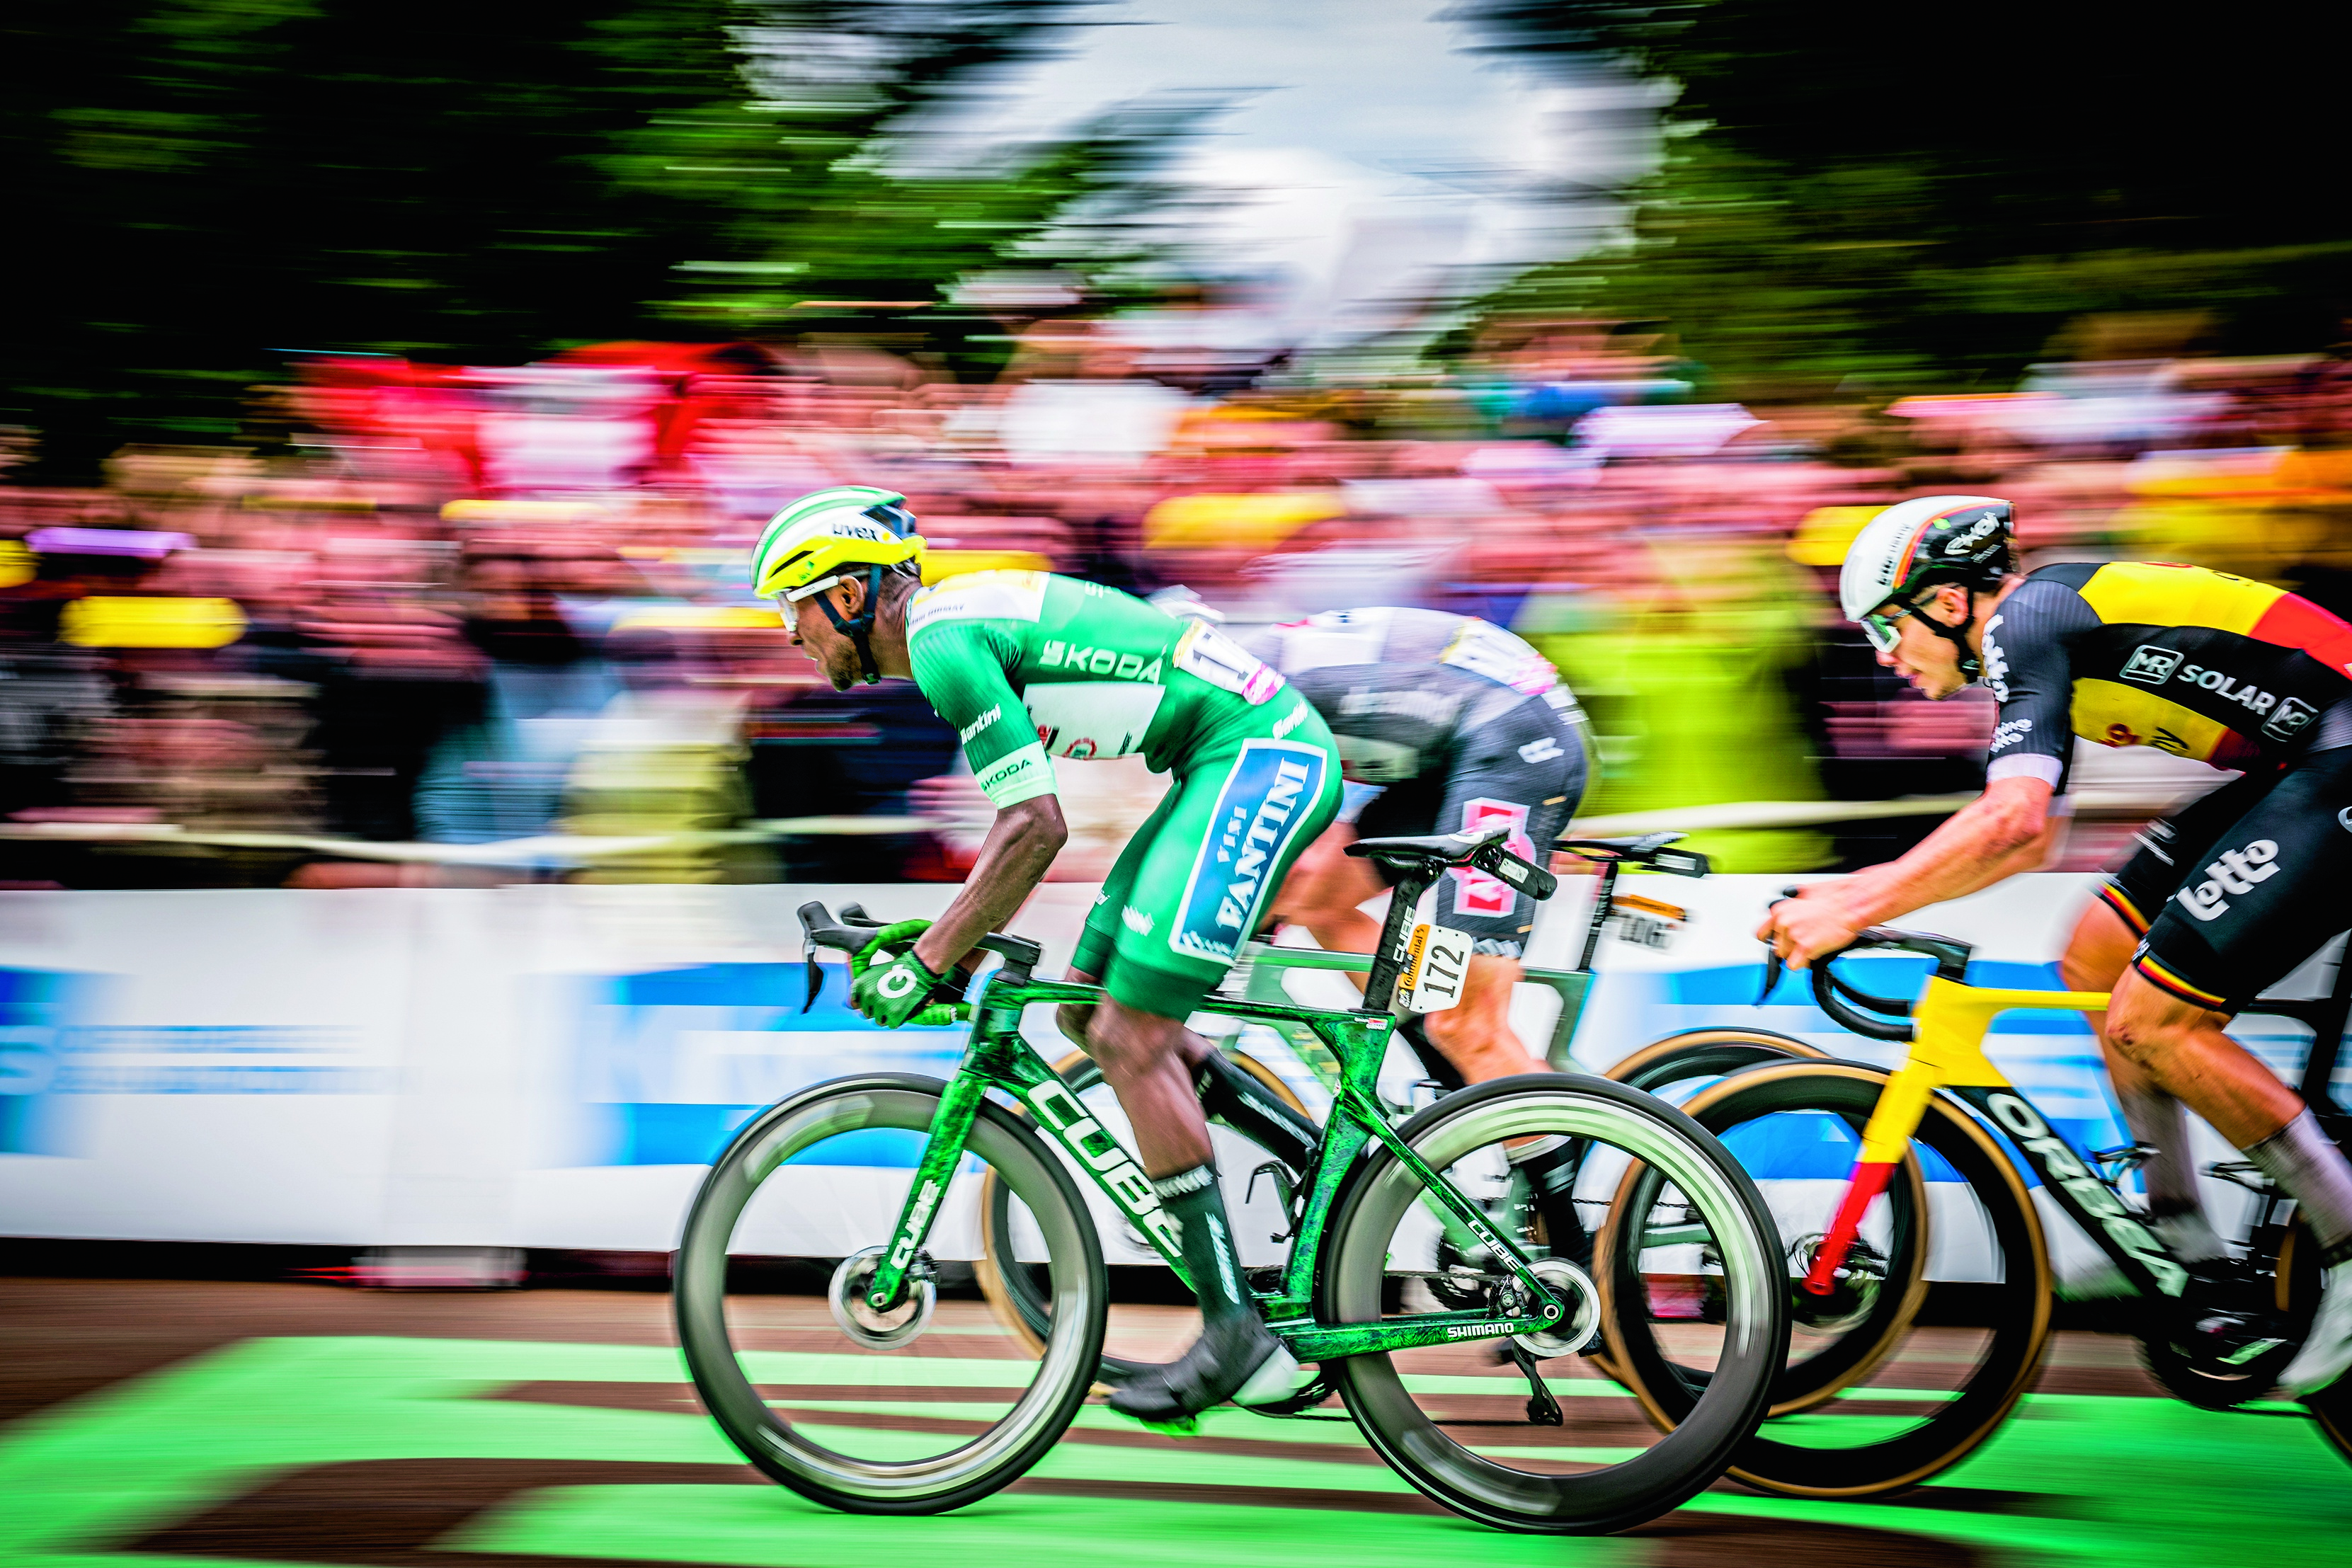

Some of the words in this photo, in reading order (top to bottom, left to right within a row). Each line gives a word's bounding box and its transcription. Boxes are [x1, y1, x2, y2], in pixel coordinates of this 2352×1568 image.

[2176, 664, 2277, 716] SOLAR
[1393, 905, 1416, 963] CUBE
[1424, 945, 1465, 999] 172
[1986, 1093, 2190, 1298] ORBEA
[890, 1179, 942, 1270] CUBE
[1468, 1219, 1523, 1272] CUBE
[1446, 1322, 1514, 1338] SHIMANO
